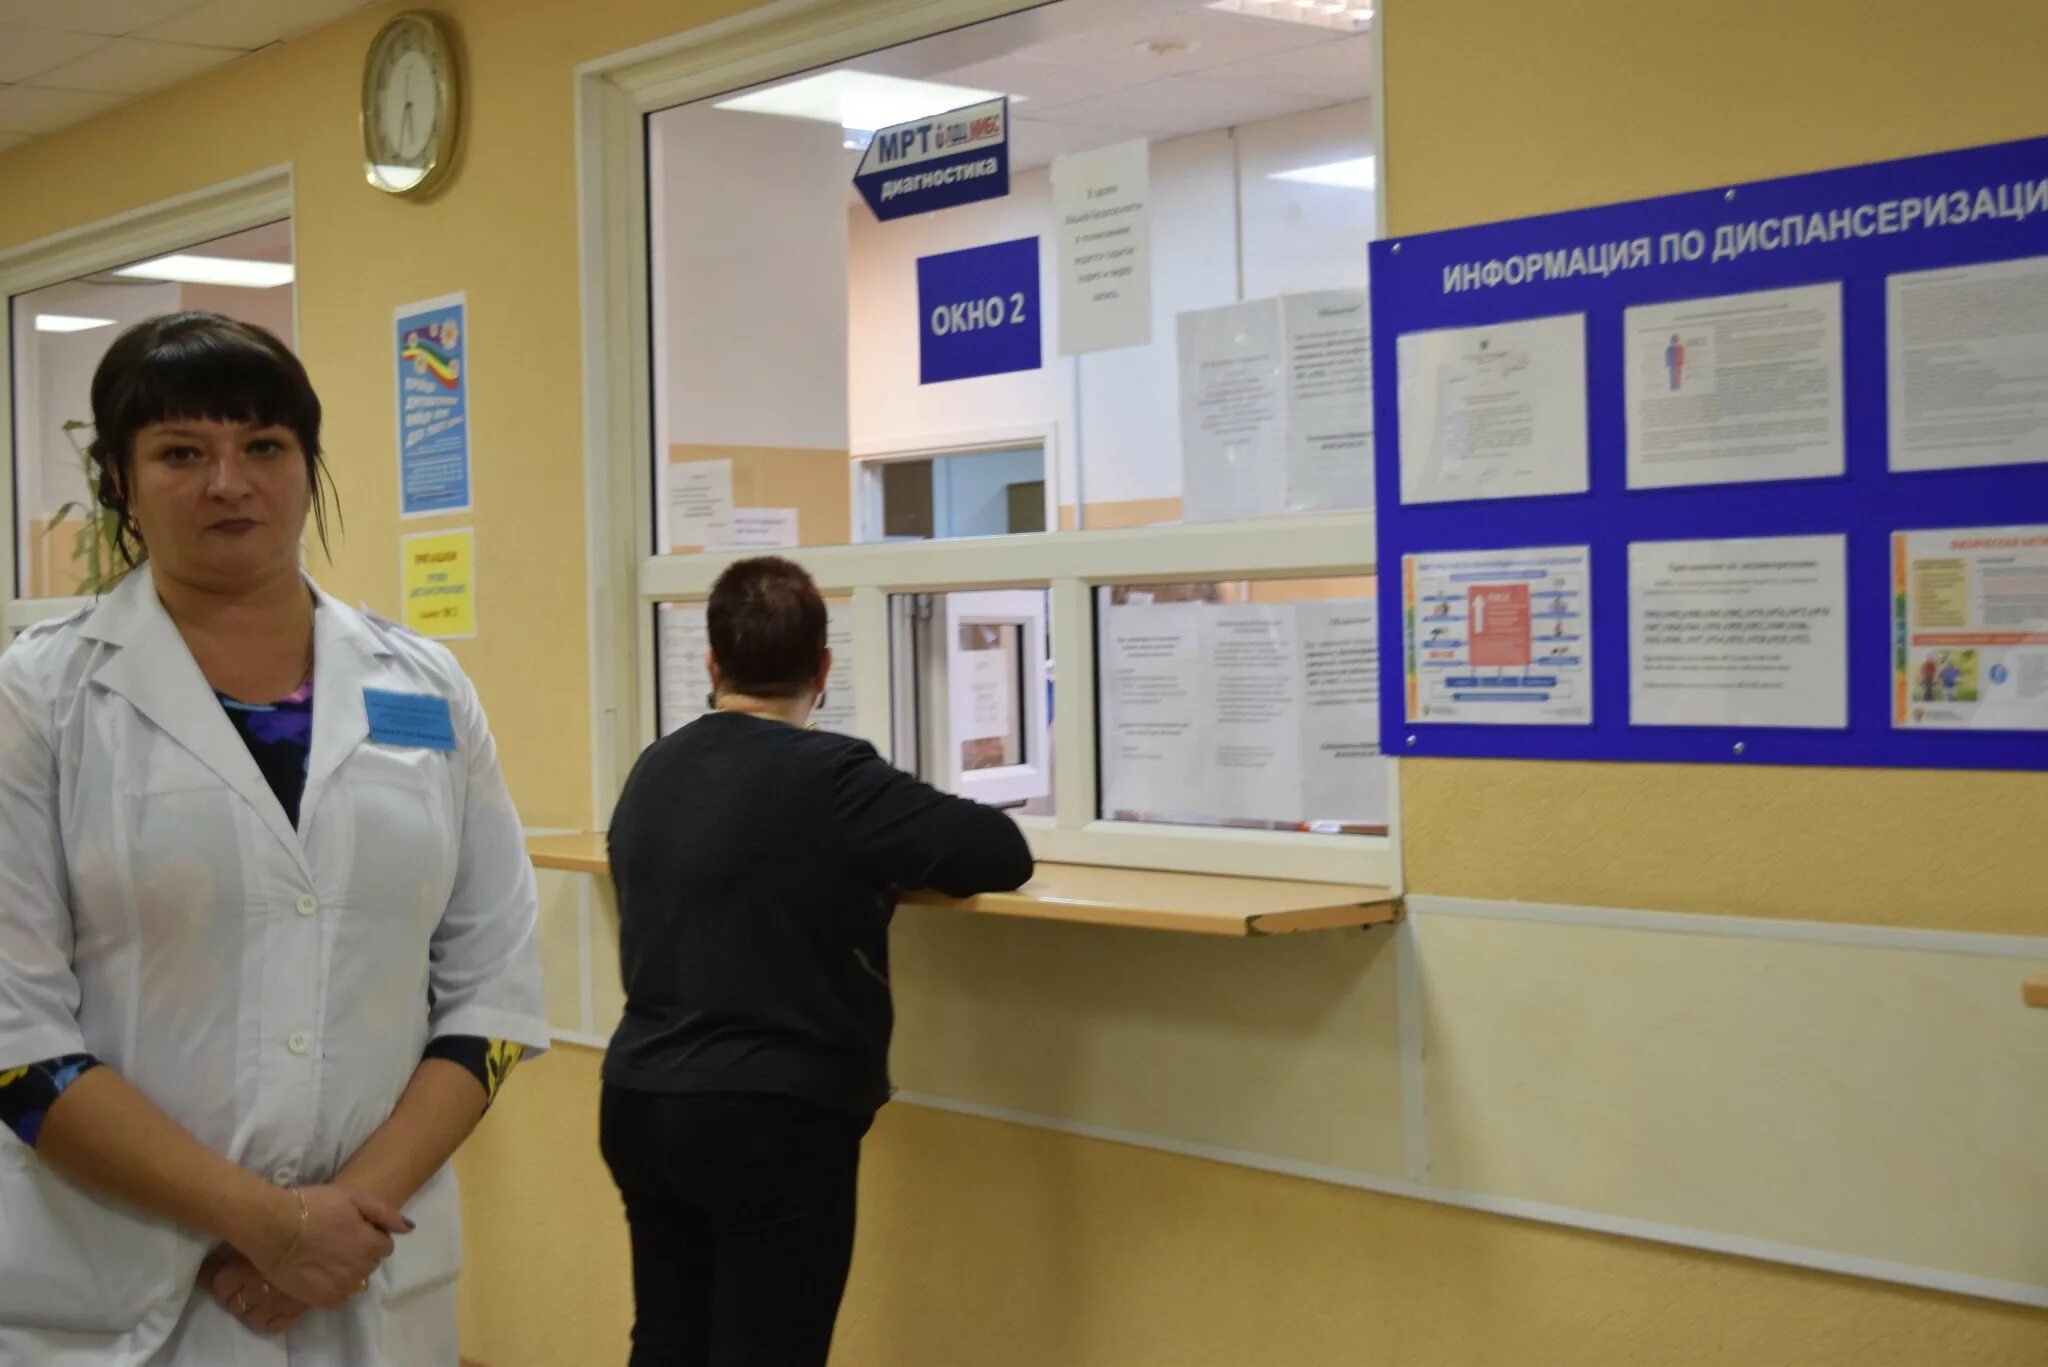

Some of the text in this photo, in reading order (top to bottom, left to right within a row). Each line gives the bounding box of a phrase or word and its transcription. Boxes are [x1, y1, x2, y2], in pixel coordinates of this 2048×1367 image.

[878, 124, 932, 163] МРТ
[881, 157, 998, 202] диагностика
[1443, 236, 1651, 294] ИНФОРМАЦИЯ
[1660, 229, 1706, 265] ПО
[931, 293, 1026, 337] ОКНО 2
